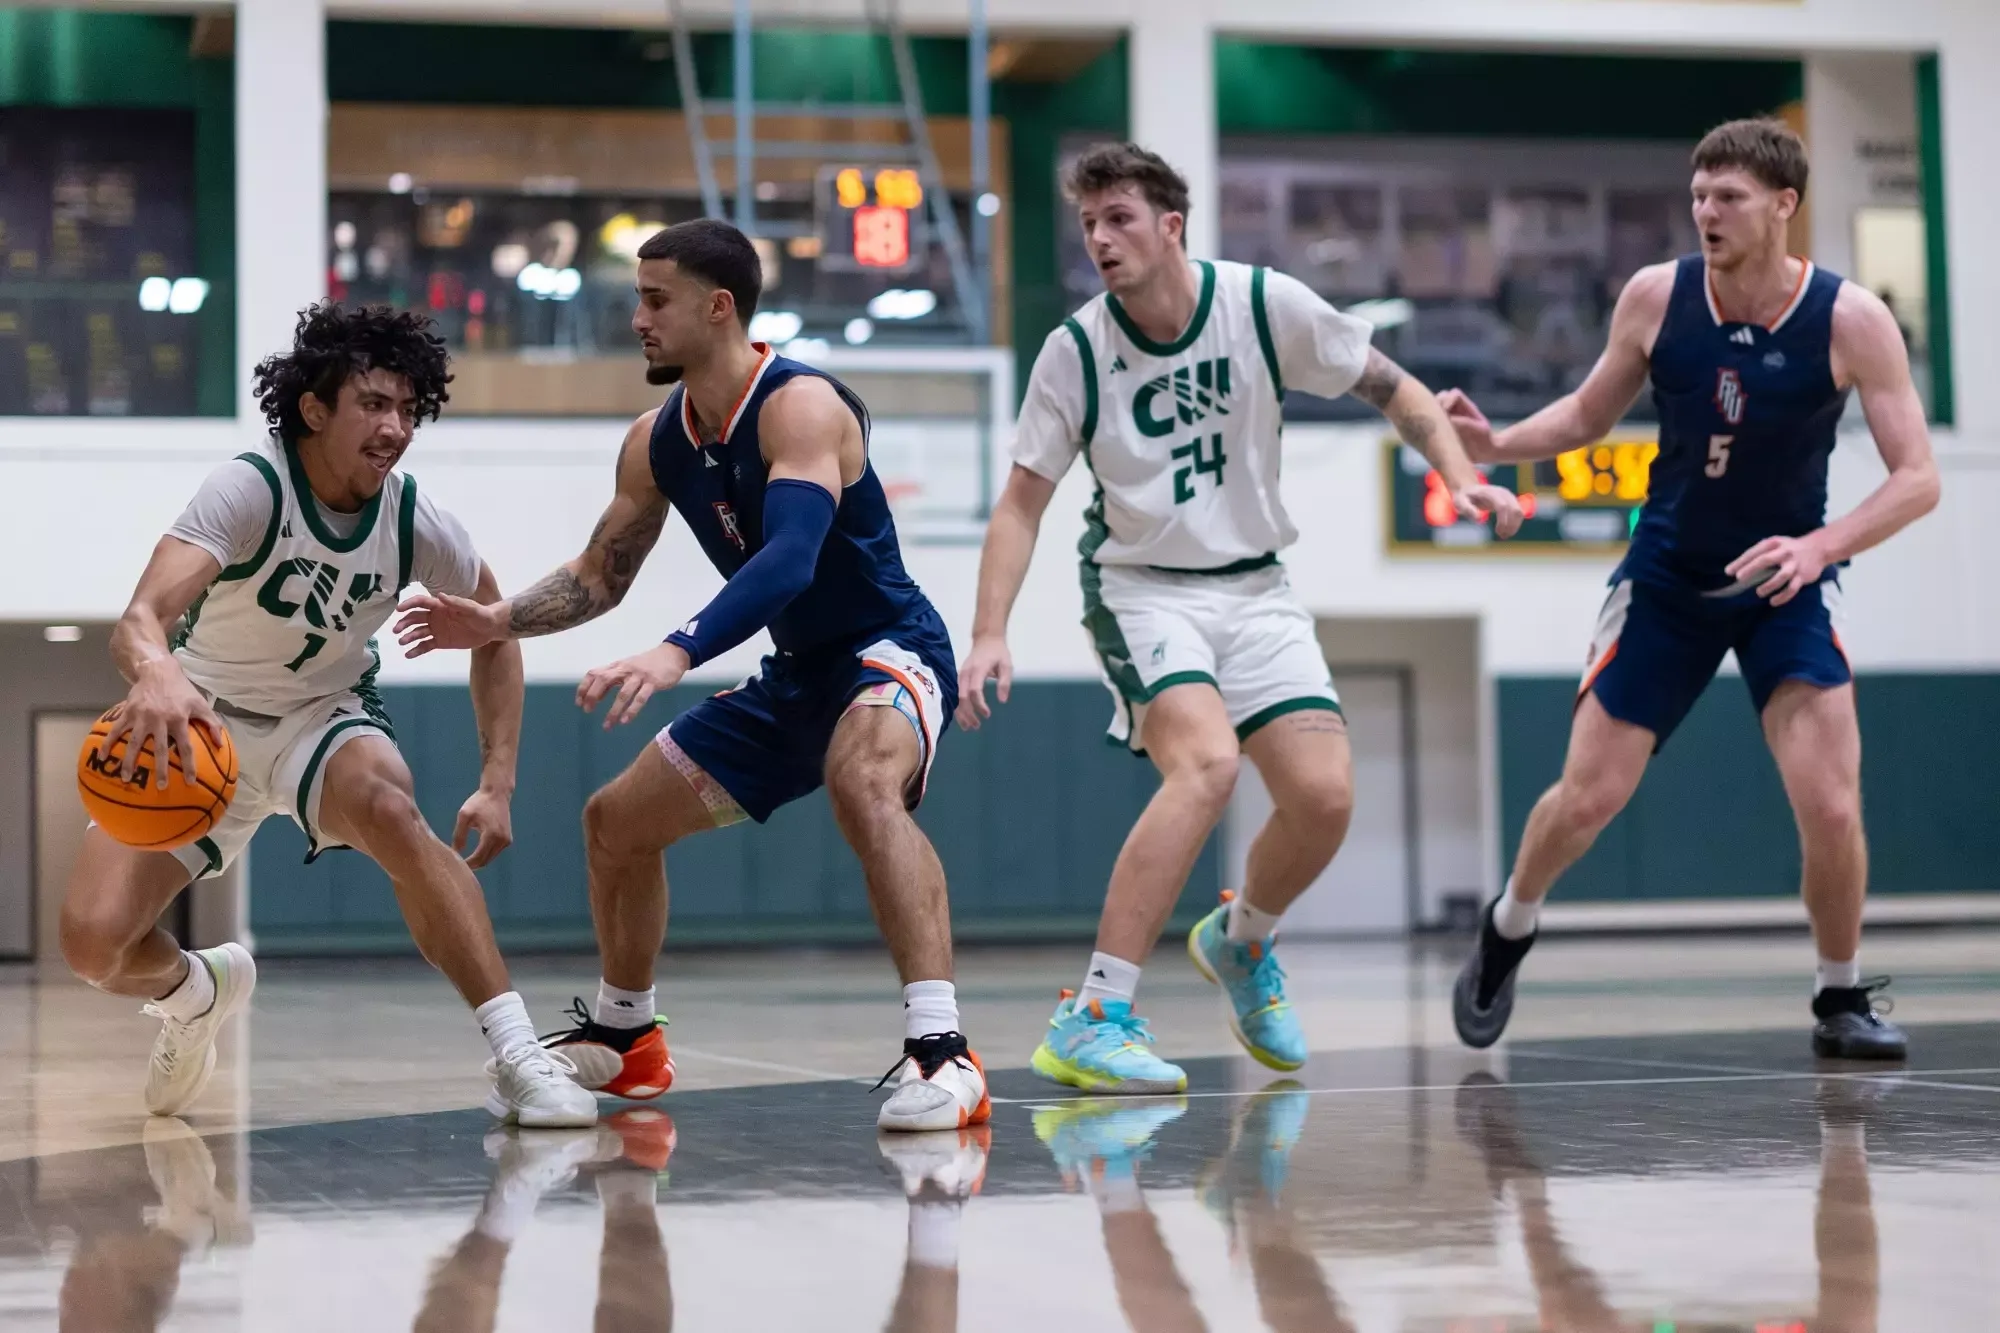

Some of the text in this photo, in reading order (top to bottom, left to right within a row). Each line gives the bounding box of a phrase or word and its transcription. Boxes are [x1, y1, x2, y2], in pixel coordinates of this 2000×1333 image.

[1171, 433, 1227, 505] 24
[1704, 434, 1735, 479] 5
[283, 633, 328, 673] 1
